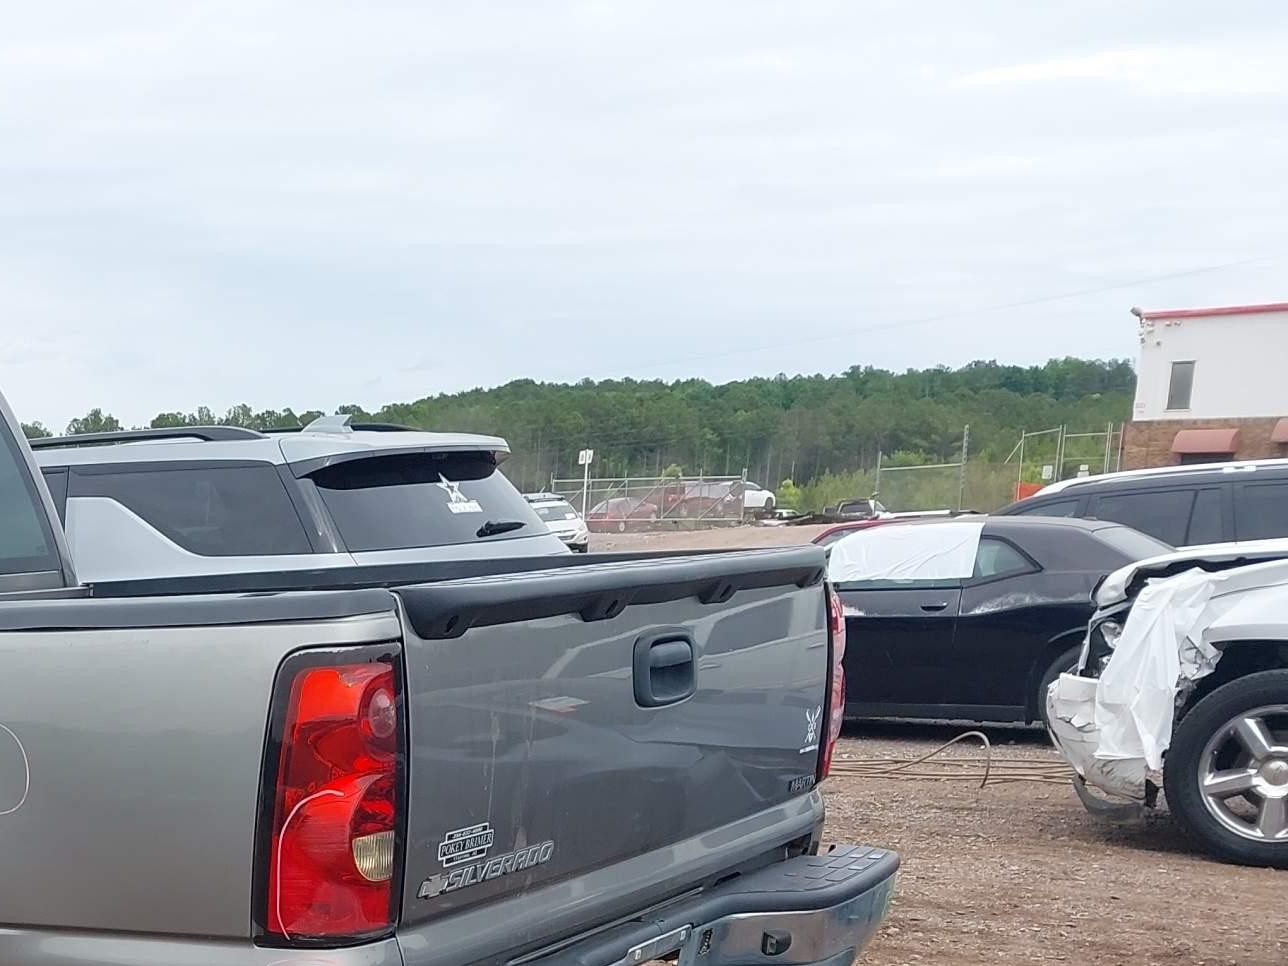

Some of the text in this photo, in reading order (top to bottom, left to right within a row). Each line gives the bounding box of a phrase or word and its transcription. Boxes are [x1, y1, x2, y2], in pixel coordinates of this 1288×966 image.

[440, 839, 464, 857] POKEY
[464, 832, 492, 850] BRIMER
[445, 839, 555, 893] SILVERADO
